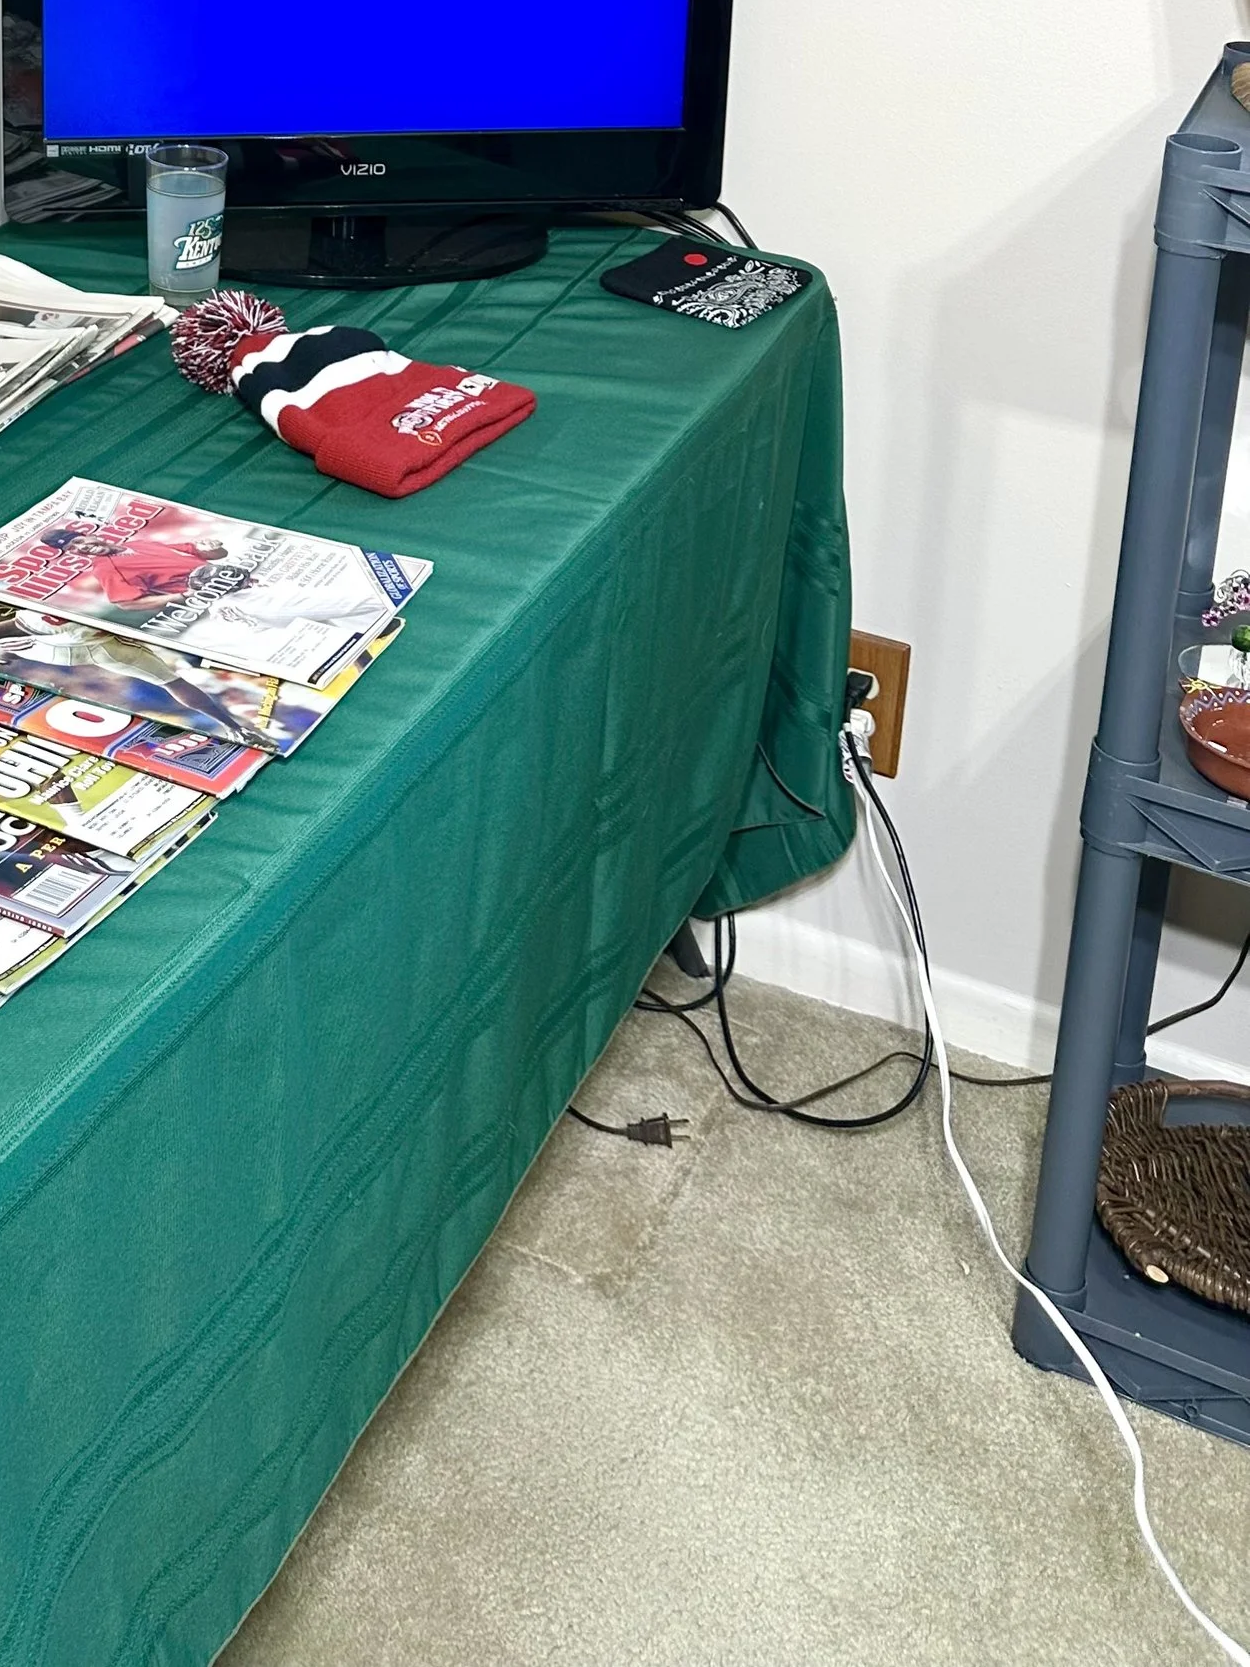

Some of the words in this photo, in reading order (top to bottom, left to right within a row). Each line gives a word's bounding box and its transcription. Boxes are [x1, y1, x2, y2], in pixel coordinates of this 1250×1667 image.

[89, 145, 122, 153] HDMI
[340, 163, 386, 176] VIZIO
[141, 566, 246, 634] Welcome
[236, 531, 285, 574] Back
[365, 552, 403, 600] GLOBALIZATION
[382, 560, 404, 584] SPORTS
[28, 771, 74, 806] Maurice
[12, 861, 30, 874] A
[27, 915, 54, 933] ISSUE
